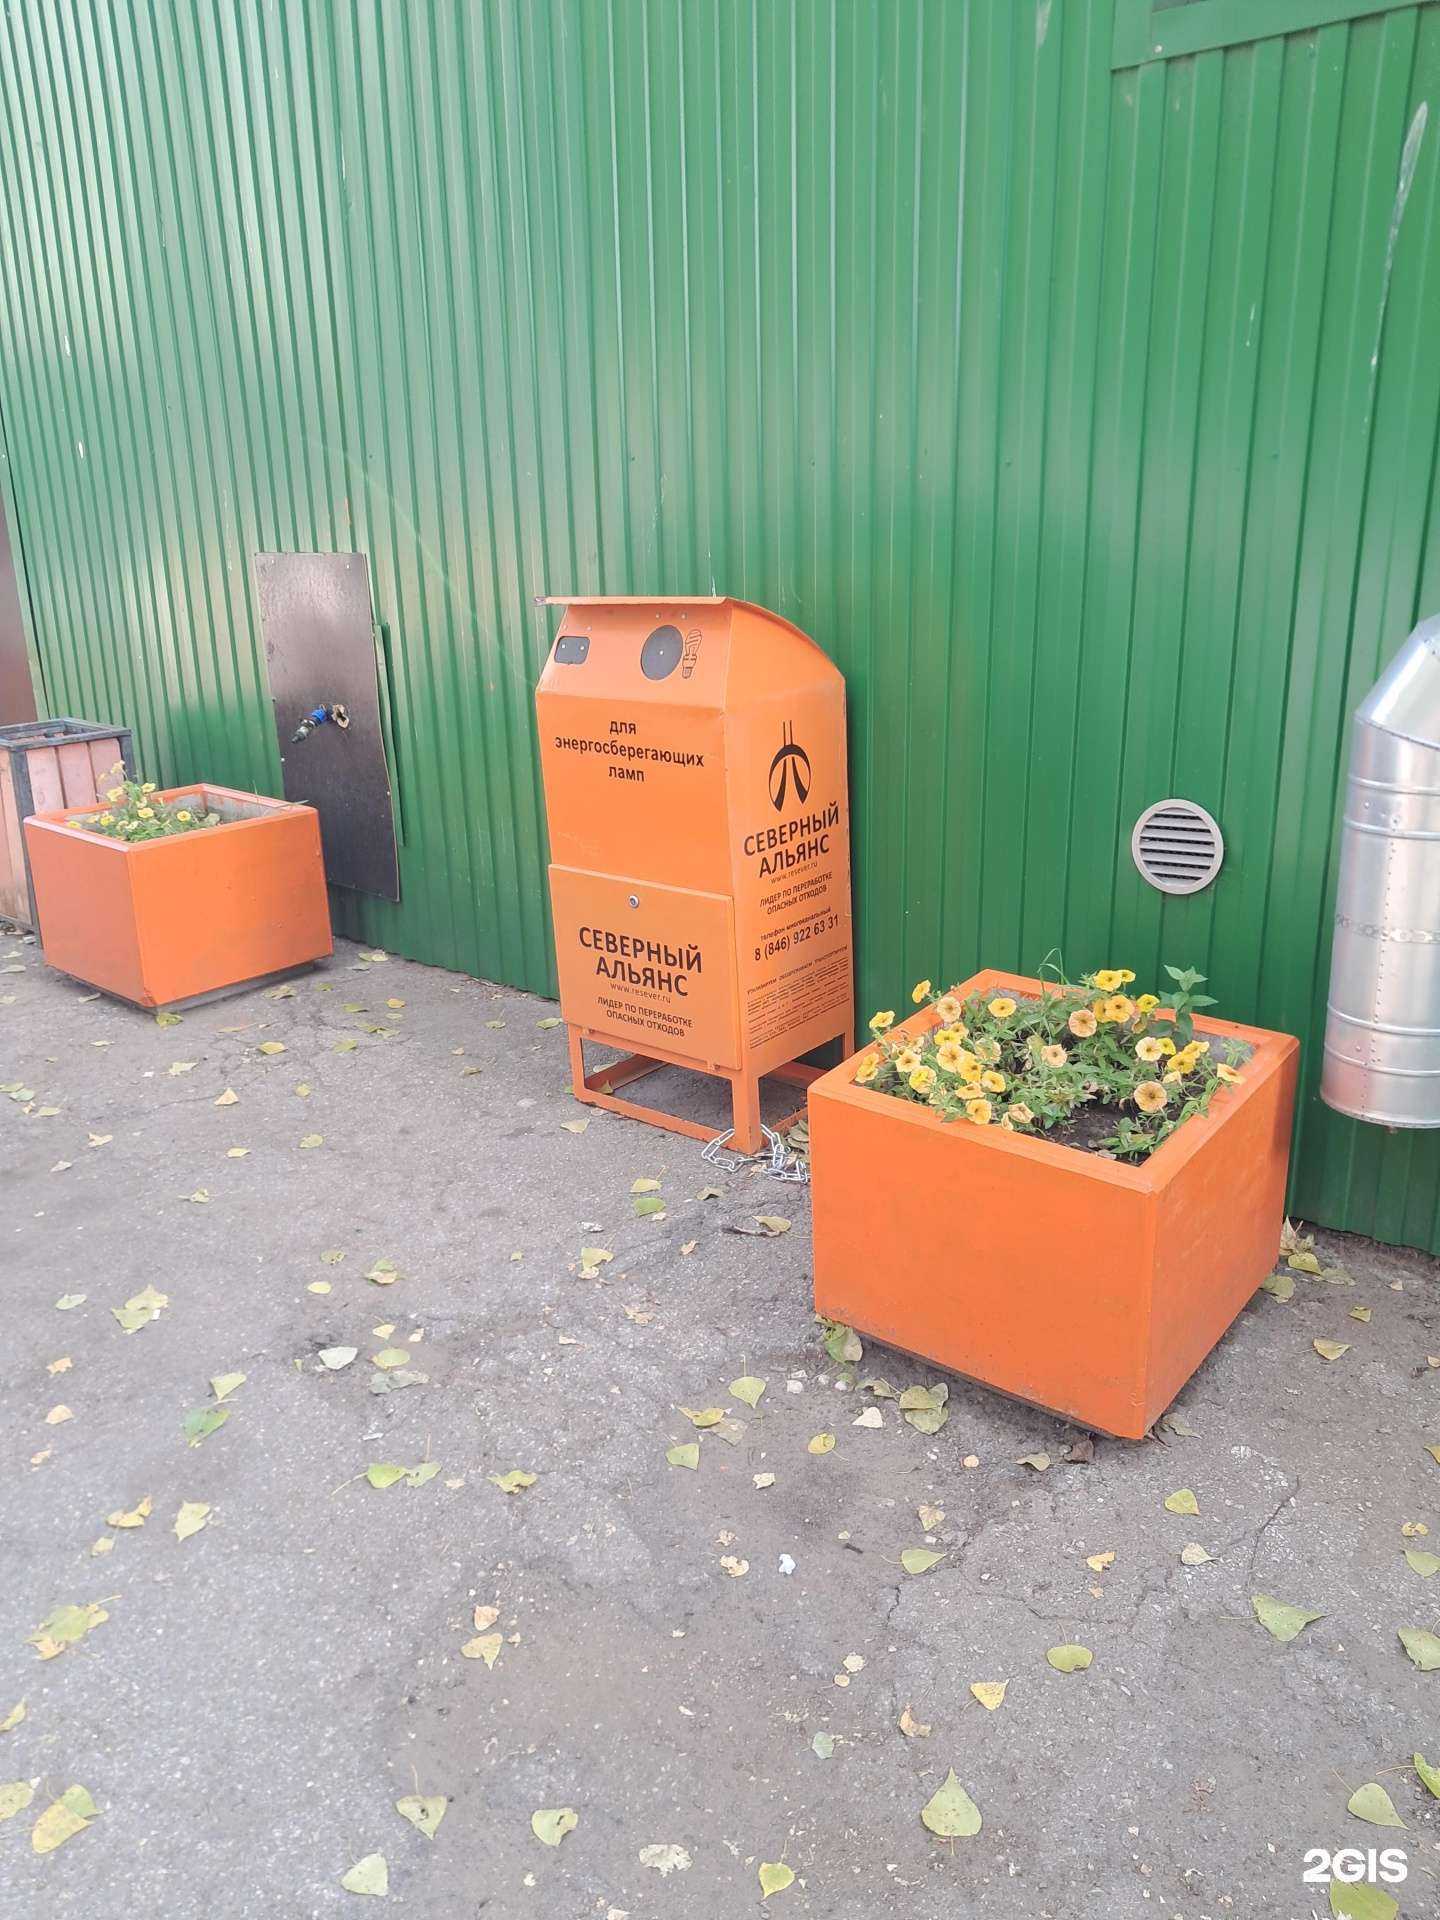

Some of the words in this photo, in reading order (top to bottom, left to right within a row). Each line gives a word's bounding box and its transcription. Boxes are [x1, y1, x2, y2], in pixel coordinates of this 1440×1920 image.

[610, 721, 637, 735] для
[555, 736, 704, 767] энергосберегающих
[609, 766, 645, 782] ламп
[744, 801, 839, 856] СЕВЕРНЫЙ
[759, 834, 829, 878] АЛЬЯНС
[760, 892, 781, 907] ЛИДЕР
[782, 888, 792, 899] ПО
[793, 872, 832, 893] ПЕРЕРАБОТКЕ
[767, 896, 798, 914] ОПАСНЫХ
[798, 884, 827, 902] ОТХОДОВ
[579, 926, 702, 973] СЕВЕРНЫЙ
[754, 948, 761, 961] 8
[765, 936, 791, 960] (846)
[793, 927, 811, 944] 922
[814, 919, 826, 936] 63
[828, 914, 839, 930] 31
[596, 956, 688, 997] АЛЬЯНС
[610, 982, 671, 1004] www.resever.ru
[597, 996, 623, 1010] ЛИДЕР
[625, 1003, 637, 1014] ПО
[638, 1006, 694, 1028] ПЕРЕРАБОТКЕ
[606, 1009, 645, 1026] ОПАСНЫХ
[647, 1020, 686, 1037] ОТХОДОВ
